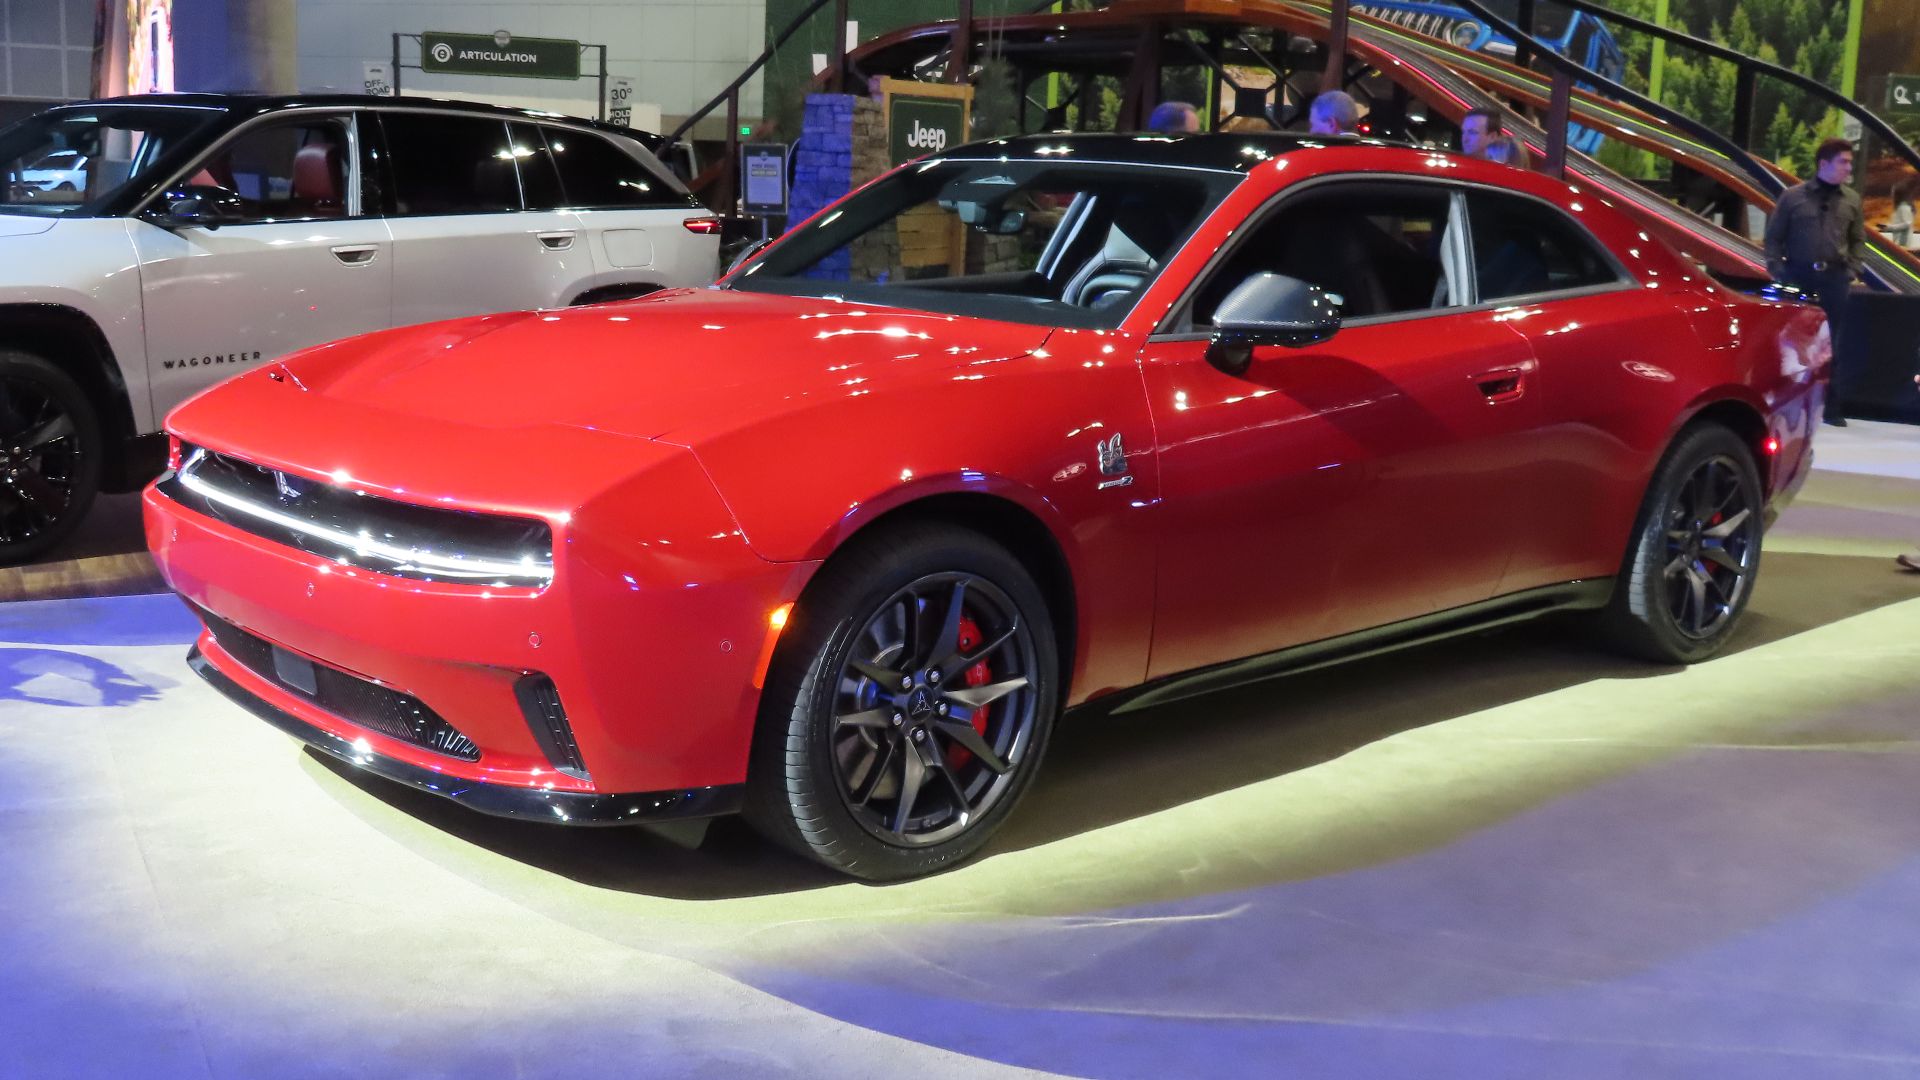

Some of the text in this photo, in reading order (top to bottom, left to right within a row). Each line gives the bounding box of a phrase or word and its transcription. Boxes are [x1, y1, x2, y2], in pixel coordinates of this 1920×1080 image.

[459, 50, 537, 63] ARTICULATION
[609, 109, 631, 118] HOLD
[613, 117, 628, 126] ON
[907, 119, 946, 153] Jeep
[163, 351, 261, 369] WAGONEER
